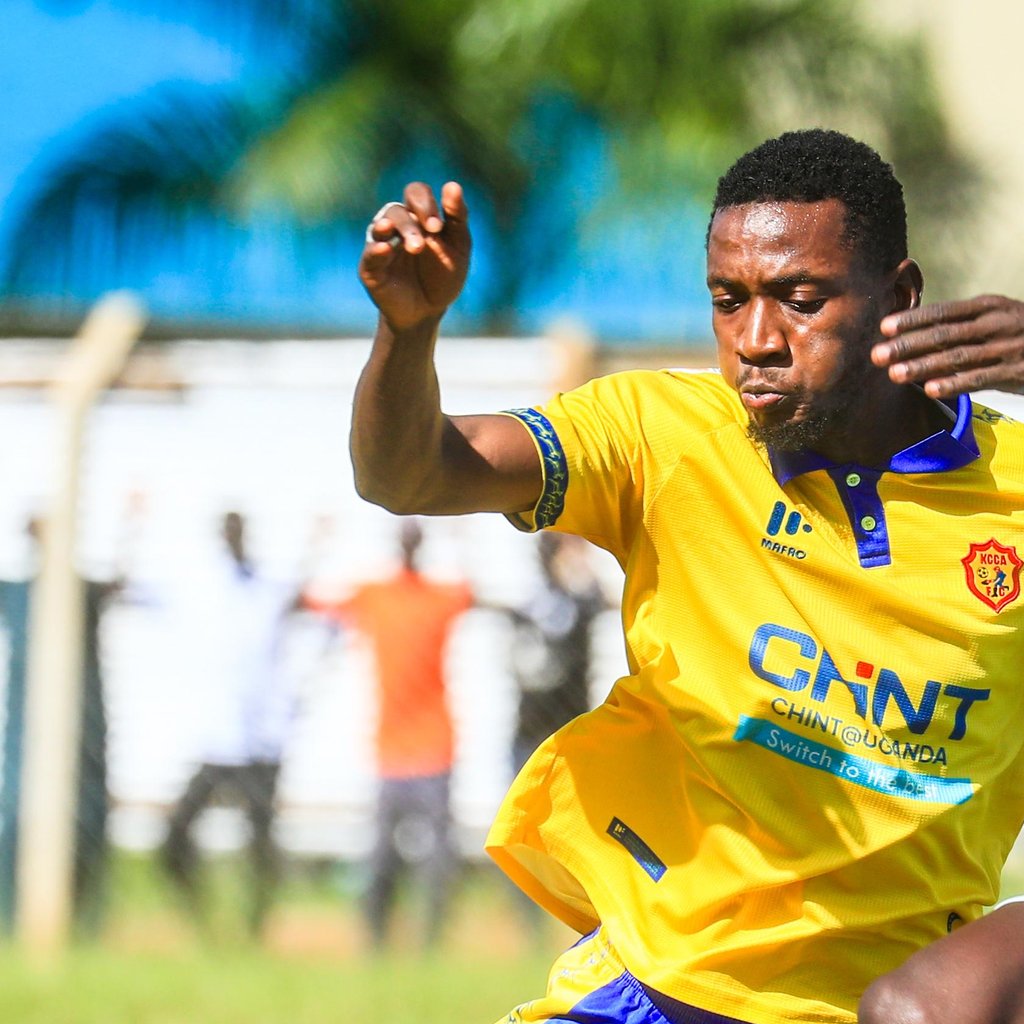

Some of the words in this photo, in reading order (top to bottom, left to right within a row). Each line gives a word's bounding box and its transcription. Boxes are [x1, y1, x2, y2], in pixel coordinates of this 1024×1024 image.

[761, 538, 806, 559] MAFRO
[980, 553, 1007, 565] KCCA
[771, 697, 947, 766] CHINT@UGANDA
[767, 729, 832, 768] Switch
[839, 760, 860, 778] to
[867, 769, 897, 792] the
